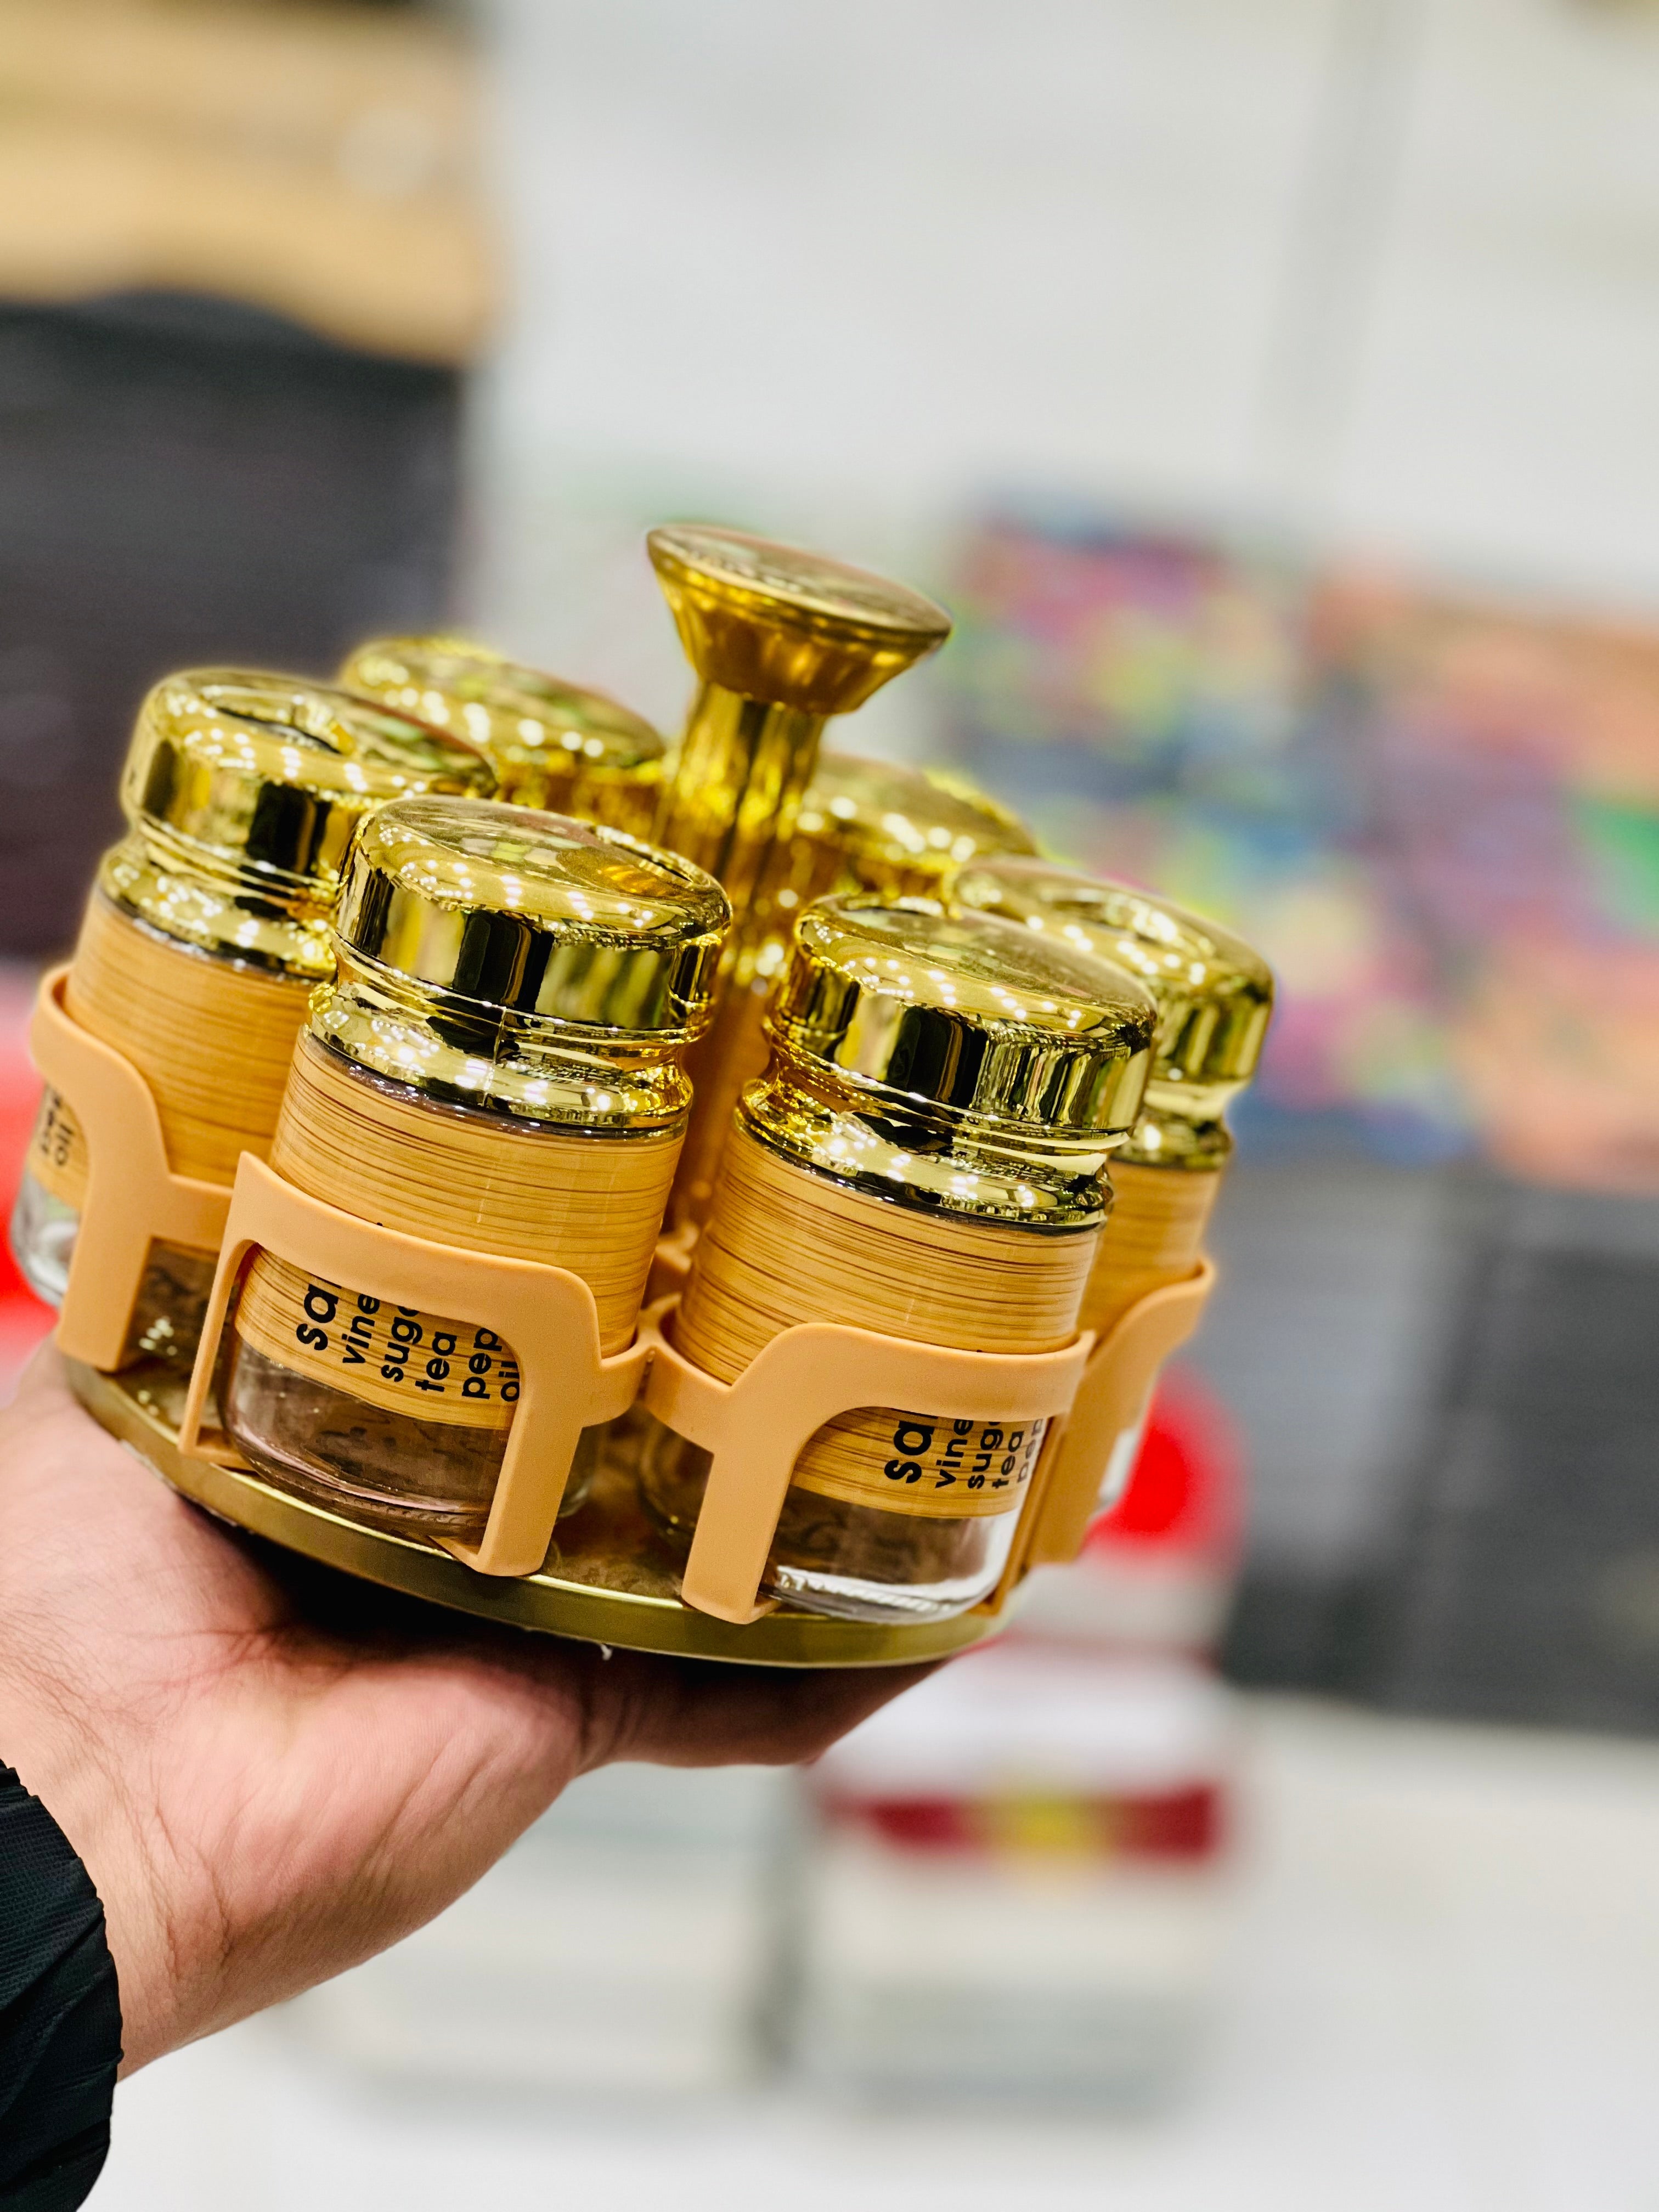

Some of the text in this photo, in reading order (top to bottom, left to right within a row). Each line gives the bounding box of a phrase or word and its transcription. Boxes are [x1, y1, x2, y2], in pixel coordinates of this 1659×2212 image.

[296, 1277, 341, 1351] sa
[415, 1331, 458, 1392] tea
[462, 1327, 503, 1400] pep
[498, 1360, 520, 1402] oil
[884, 1408, 939, 1484] sa
[967, 1421, 1004, 1489] sug
[992, 1430, 1025, 1489] tea
